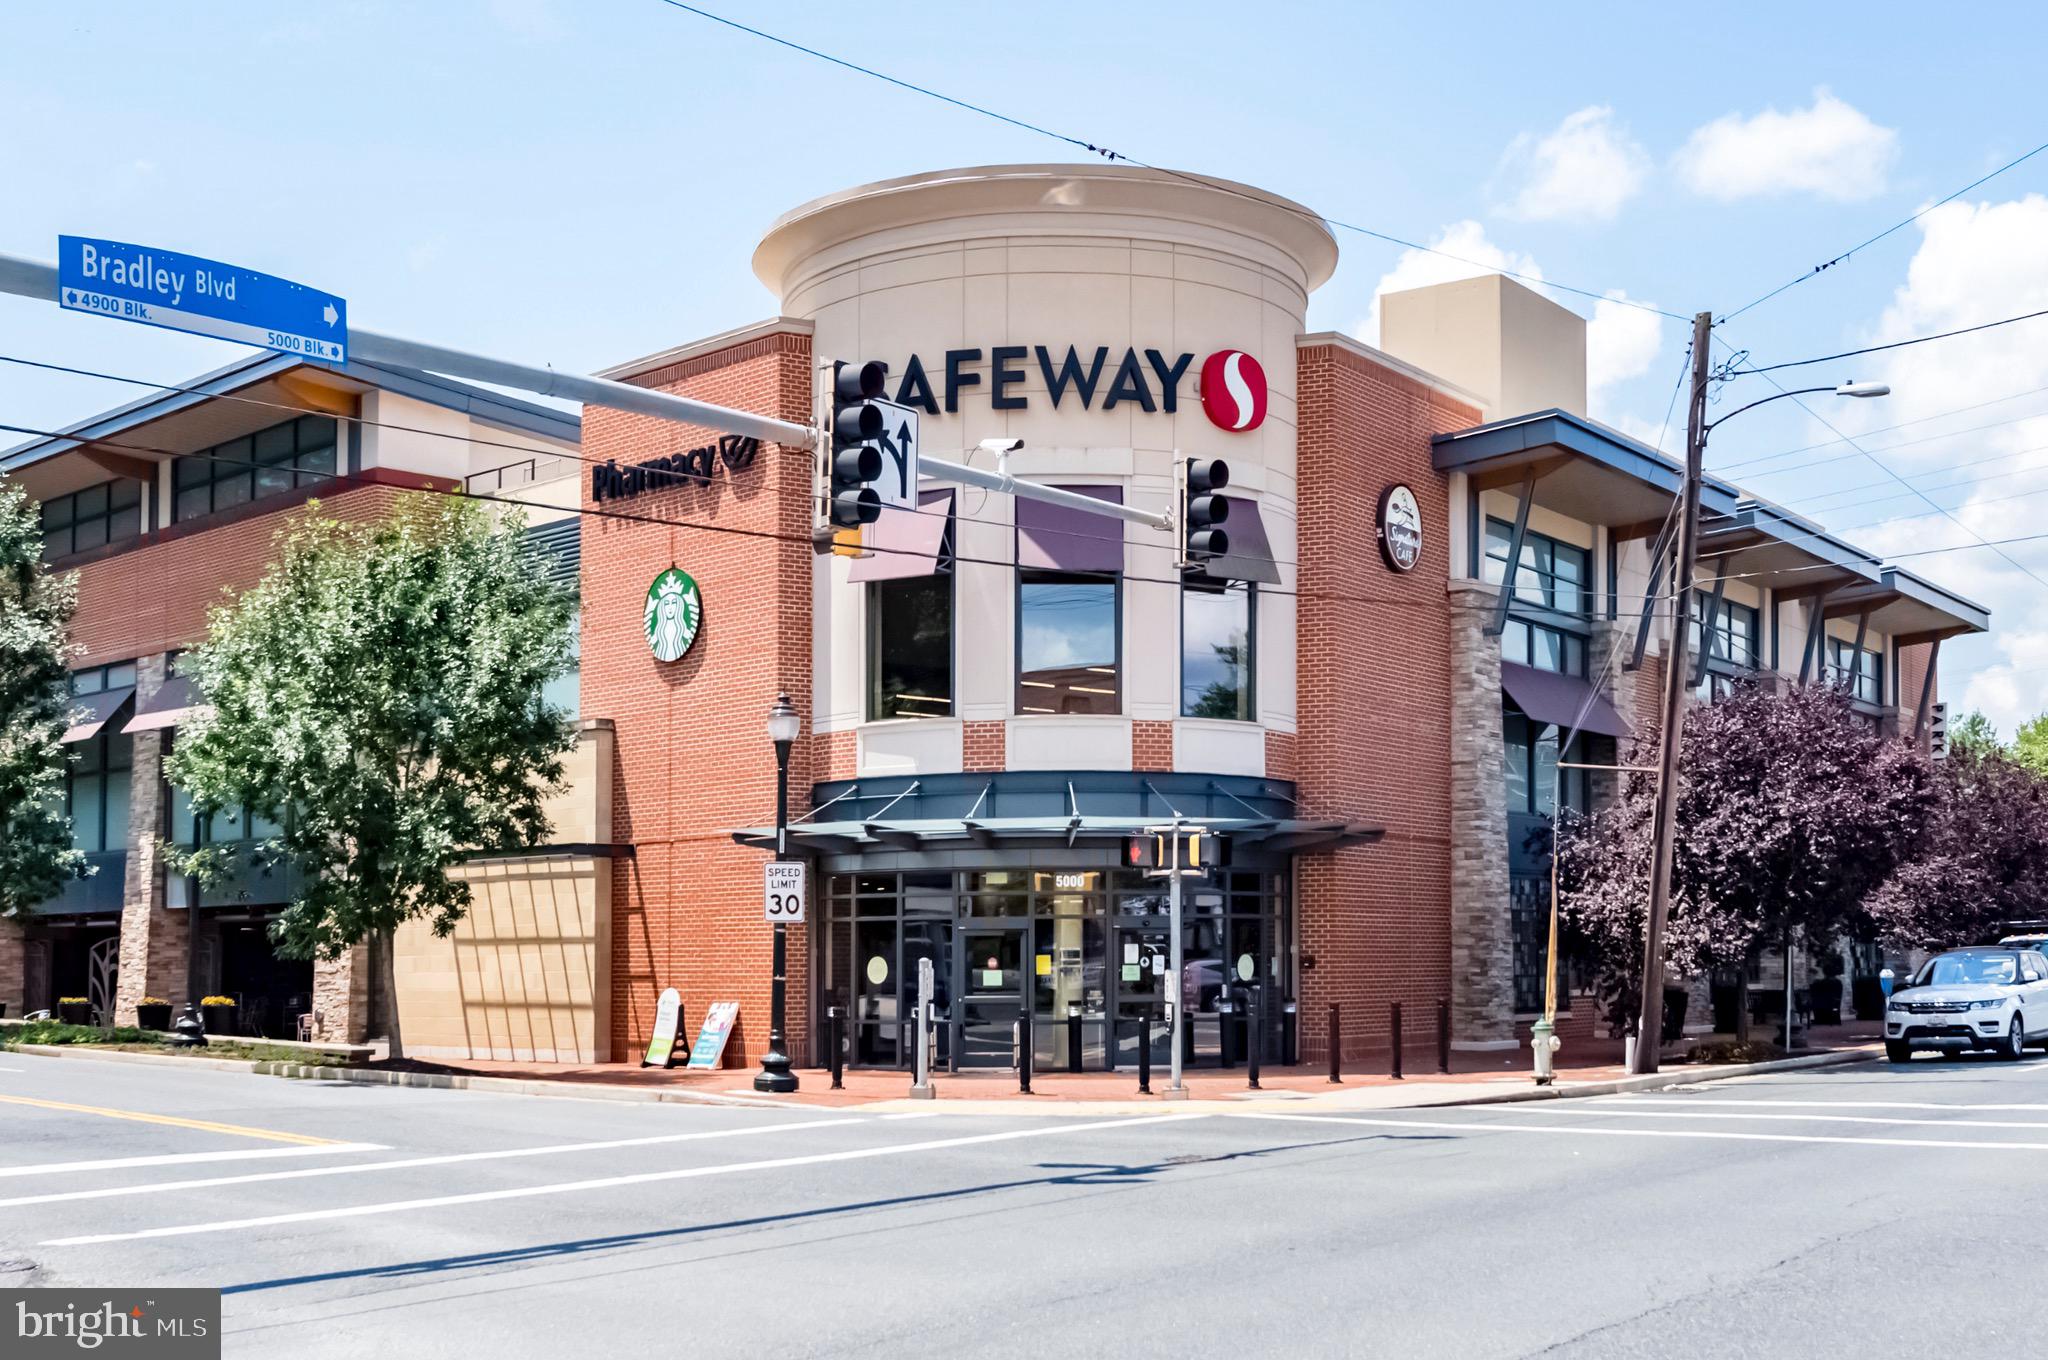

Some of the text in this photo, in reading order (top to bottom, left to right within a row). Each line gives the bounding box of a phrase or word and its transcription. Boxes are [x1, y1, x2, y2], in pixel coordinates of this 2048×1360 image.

[82, 244, 235, 305] Bradley Blvd
[81, 293, 152, 320] 4900 Blk.
[268, 332, 329, 356] 5000 Blk.
[868, 344, 1195, 415] AFEWAY
[592, 445, 716, 502] Pharmacy
[1396, 547, 1413, 563] CAFE
[1931, 705, 1944, 761] PARKI
[768, 868, 801, 877] SPEED
[771, 880, 797, 888] LIMIT
[1056, 875, 1084, 887] 5000
[769, 894, 800, 915] 30
